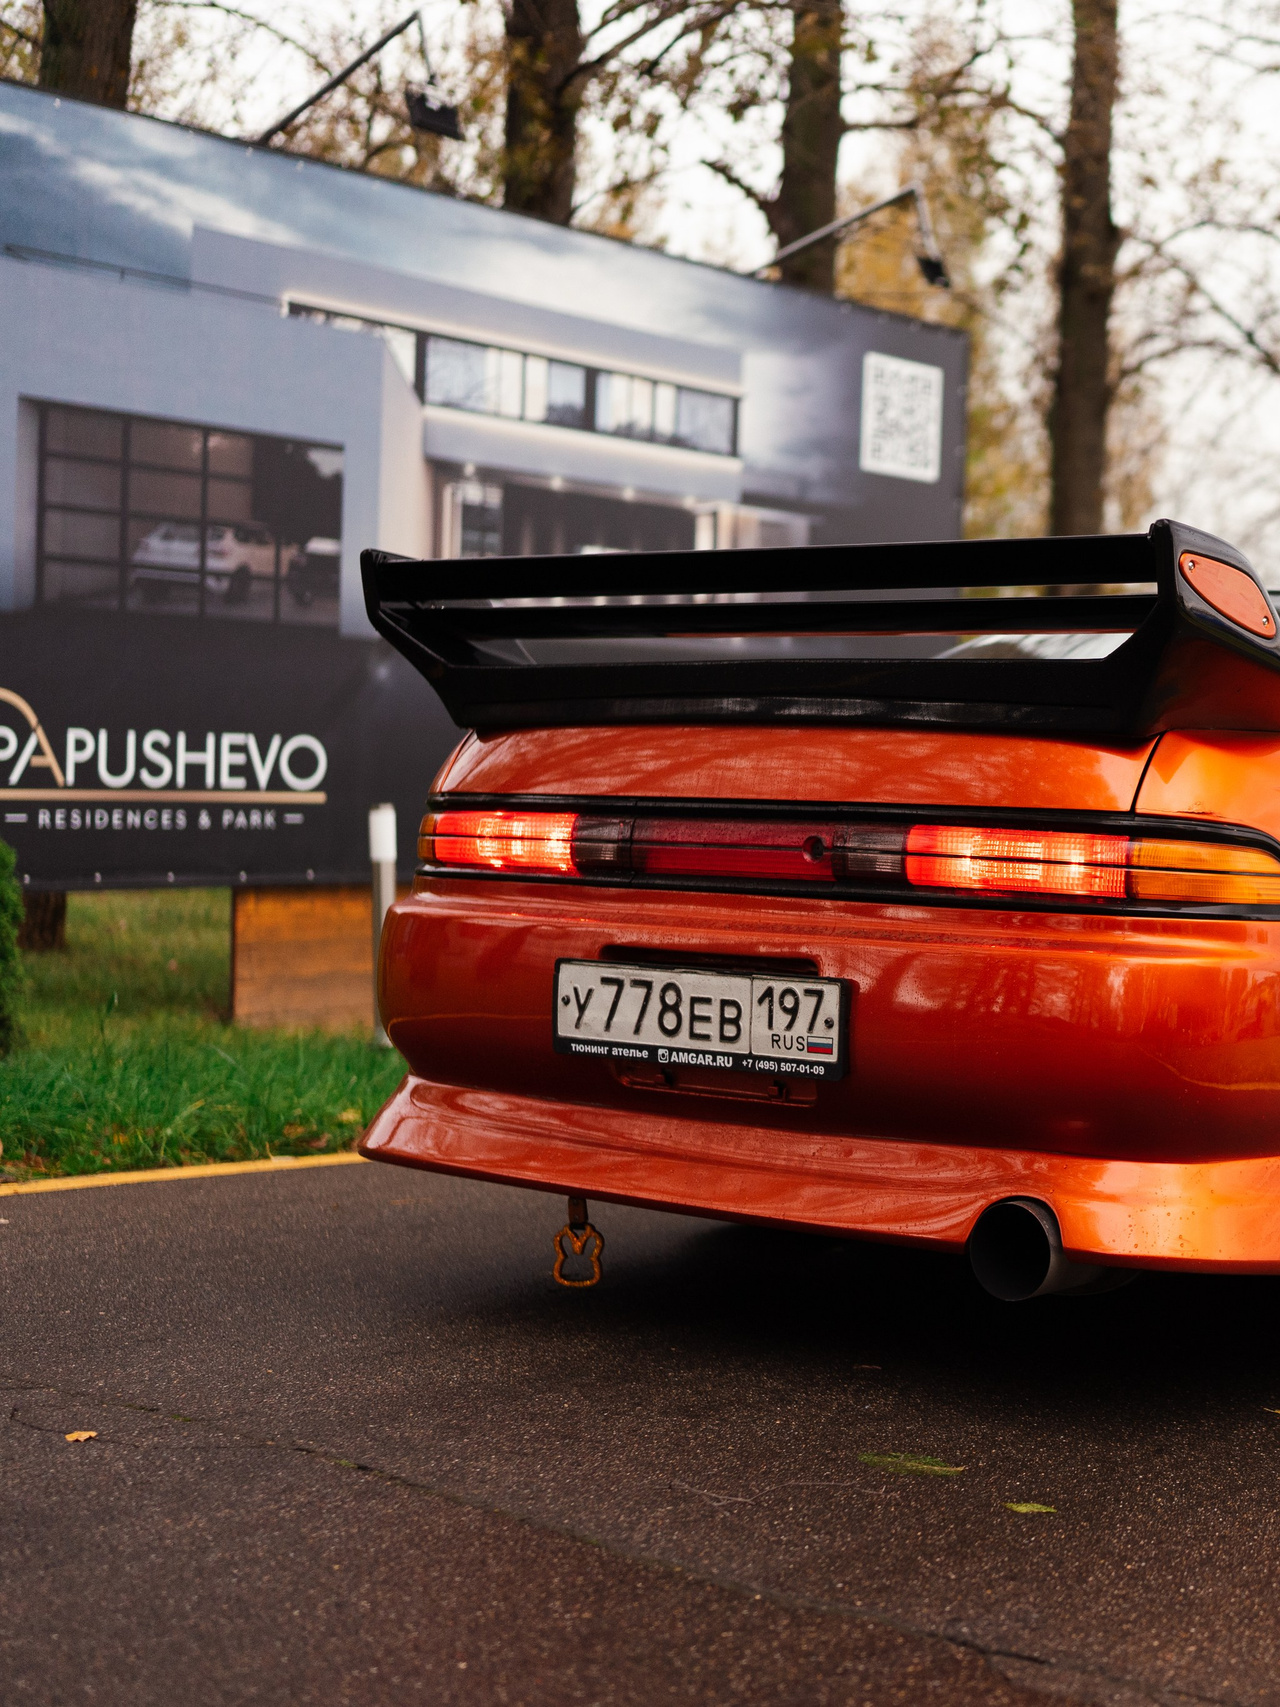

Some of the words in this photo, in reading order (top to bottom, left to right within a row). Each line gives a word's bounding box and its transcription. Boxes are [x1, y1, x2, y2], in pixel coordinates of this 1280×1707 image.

[0, 724, 328, 791] PAPUSHEVO
[38, 808, 188, 831] RESIDENCES
[198, 808, 212, 831] &
[221, 809, 278, 831] PARK
[757, 985, 825, 1035] 197
[570, 1042, 609, 1056] тюнинг
[611, 1046, 649, 1059] ателье
[670, 1051, 733, 1068] AMGAR.RU
[741, 1059, 753, 1069] +7
[755, 1059, 778, 1073] (495)
[780, 1062, 825, 1076] 507-01-09
[771, 1033, 806, 1052] RUS
